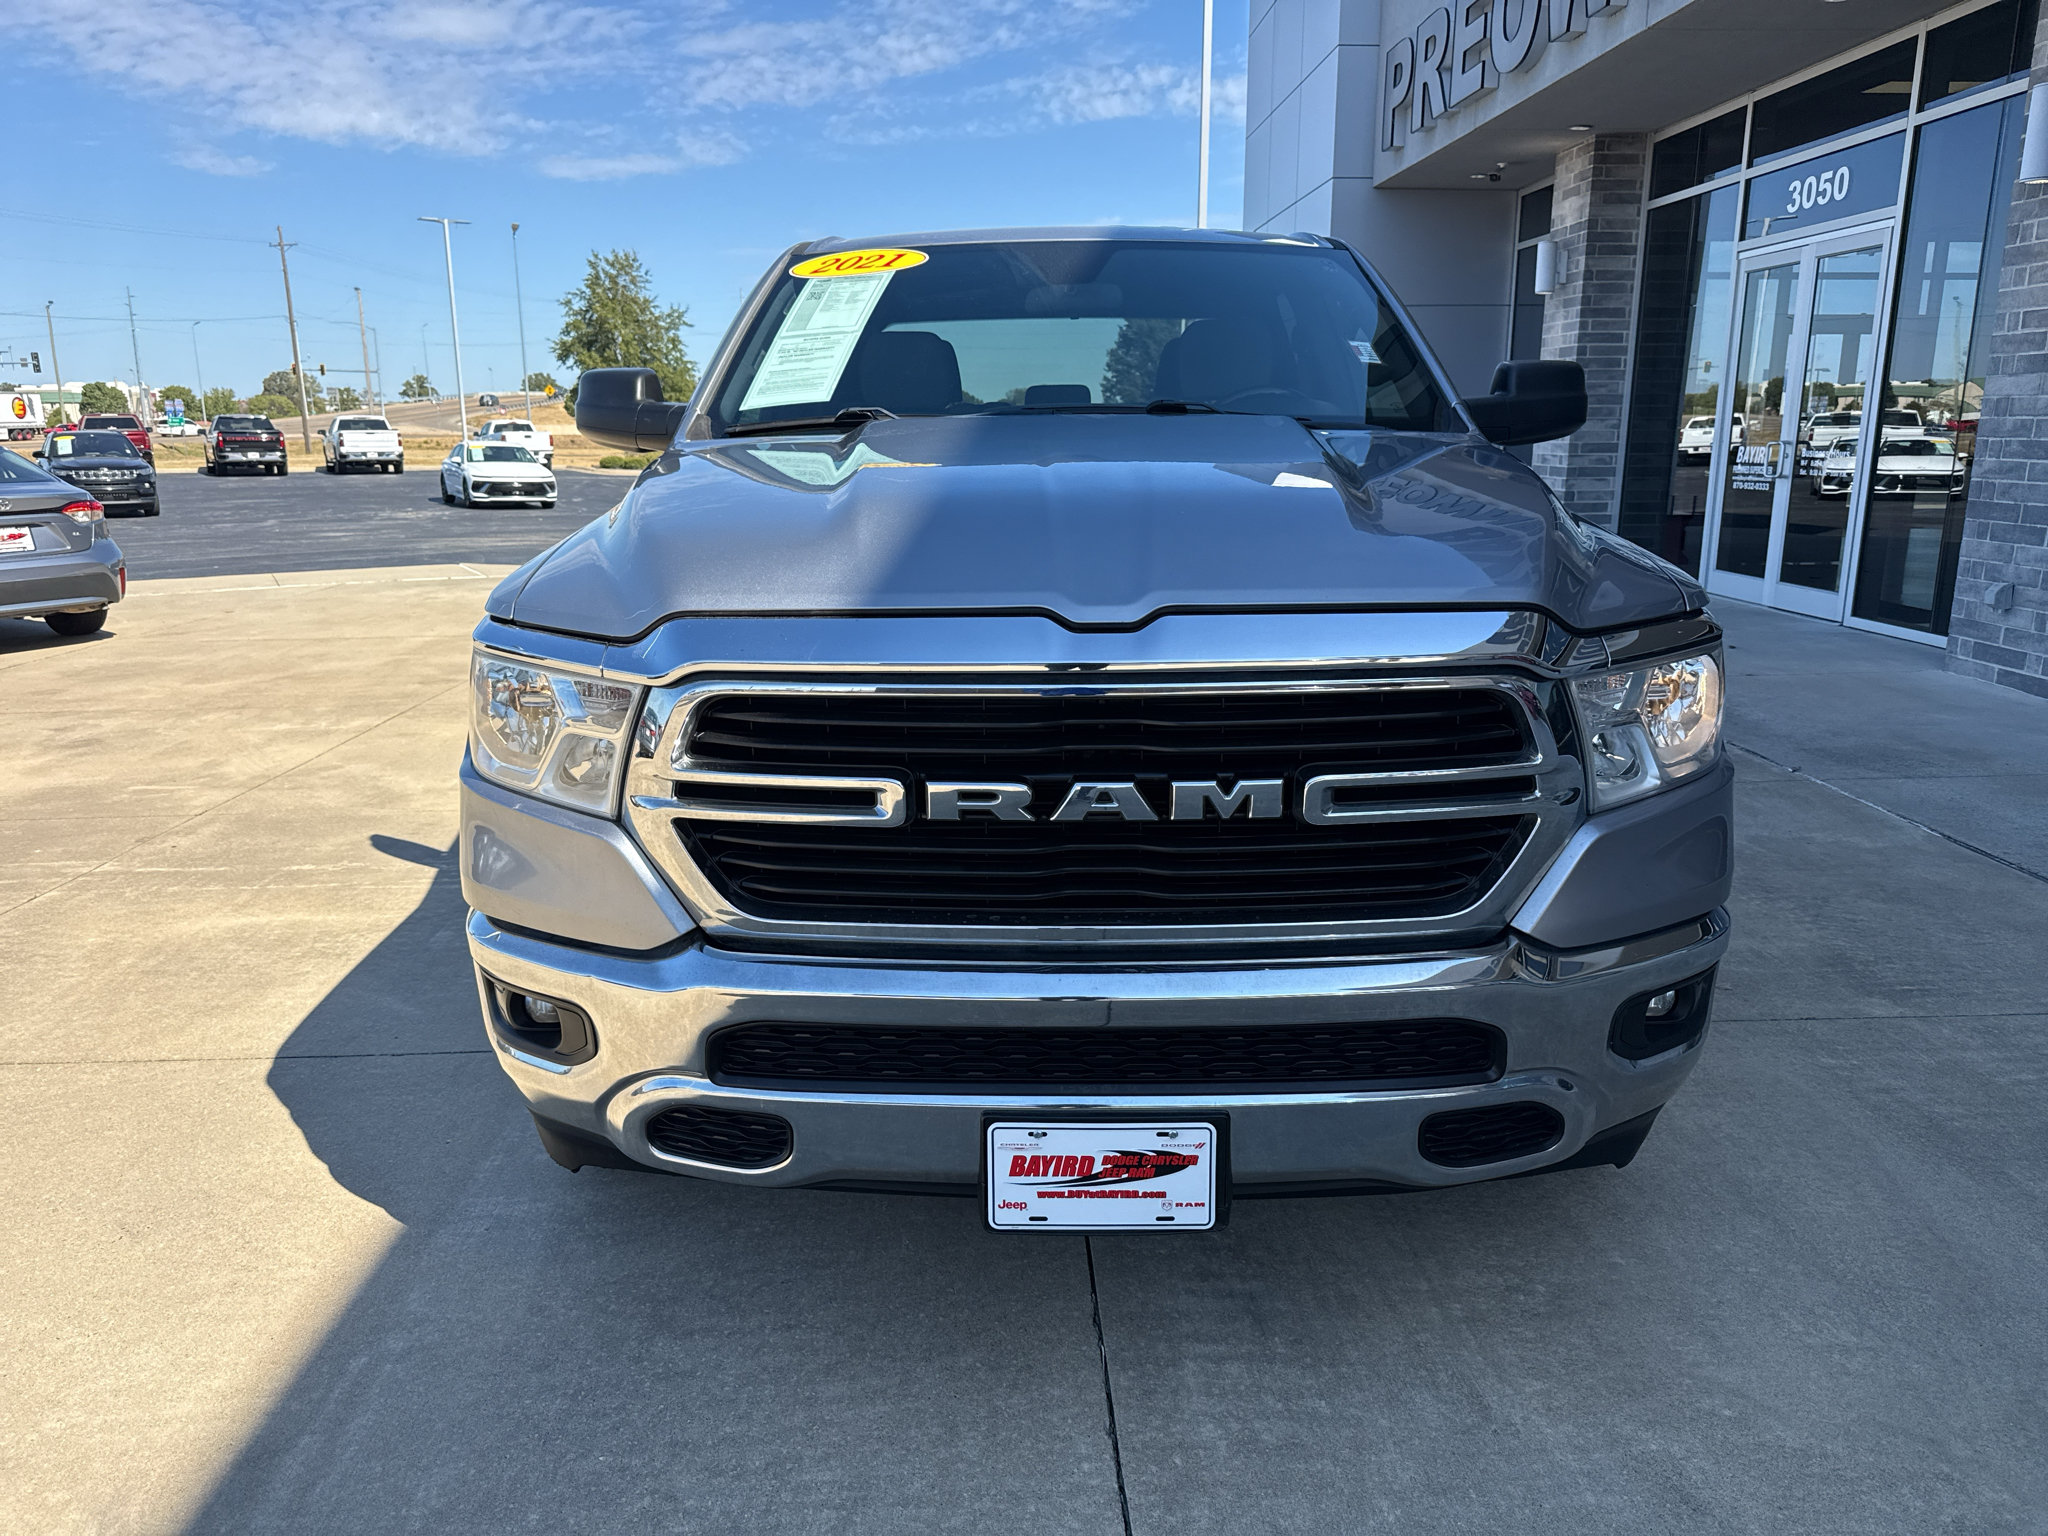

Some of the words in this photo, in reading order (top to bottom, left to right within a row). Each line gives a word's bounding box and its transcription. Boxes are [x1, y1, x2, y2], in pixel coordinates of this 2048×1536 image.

[1381, 0, 1625, 152] PREO
[1786, 166, 1850, 214] 3050
[809, 254, 905, 274] 2021
[926, 780, 1284, 820] RAM
[1009, 1155, 1096, 1177] BAYIRD
[1101, 1155, 1140, 1165] DODGE
[1141, 1155, 1199, 1165] CHRYSLER
[1098, 1167, 1126, 1178] JEEP
[1128, 1167, 1156, 1178] RAM
[998, 1199, 1027, 1211] Jeep
